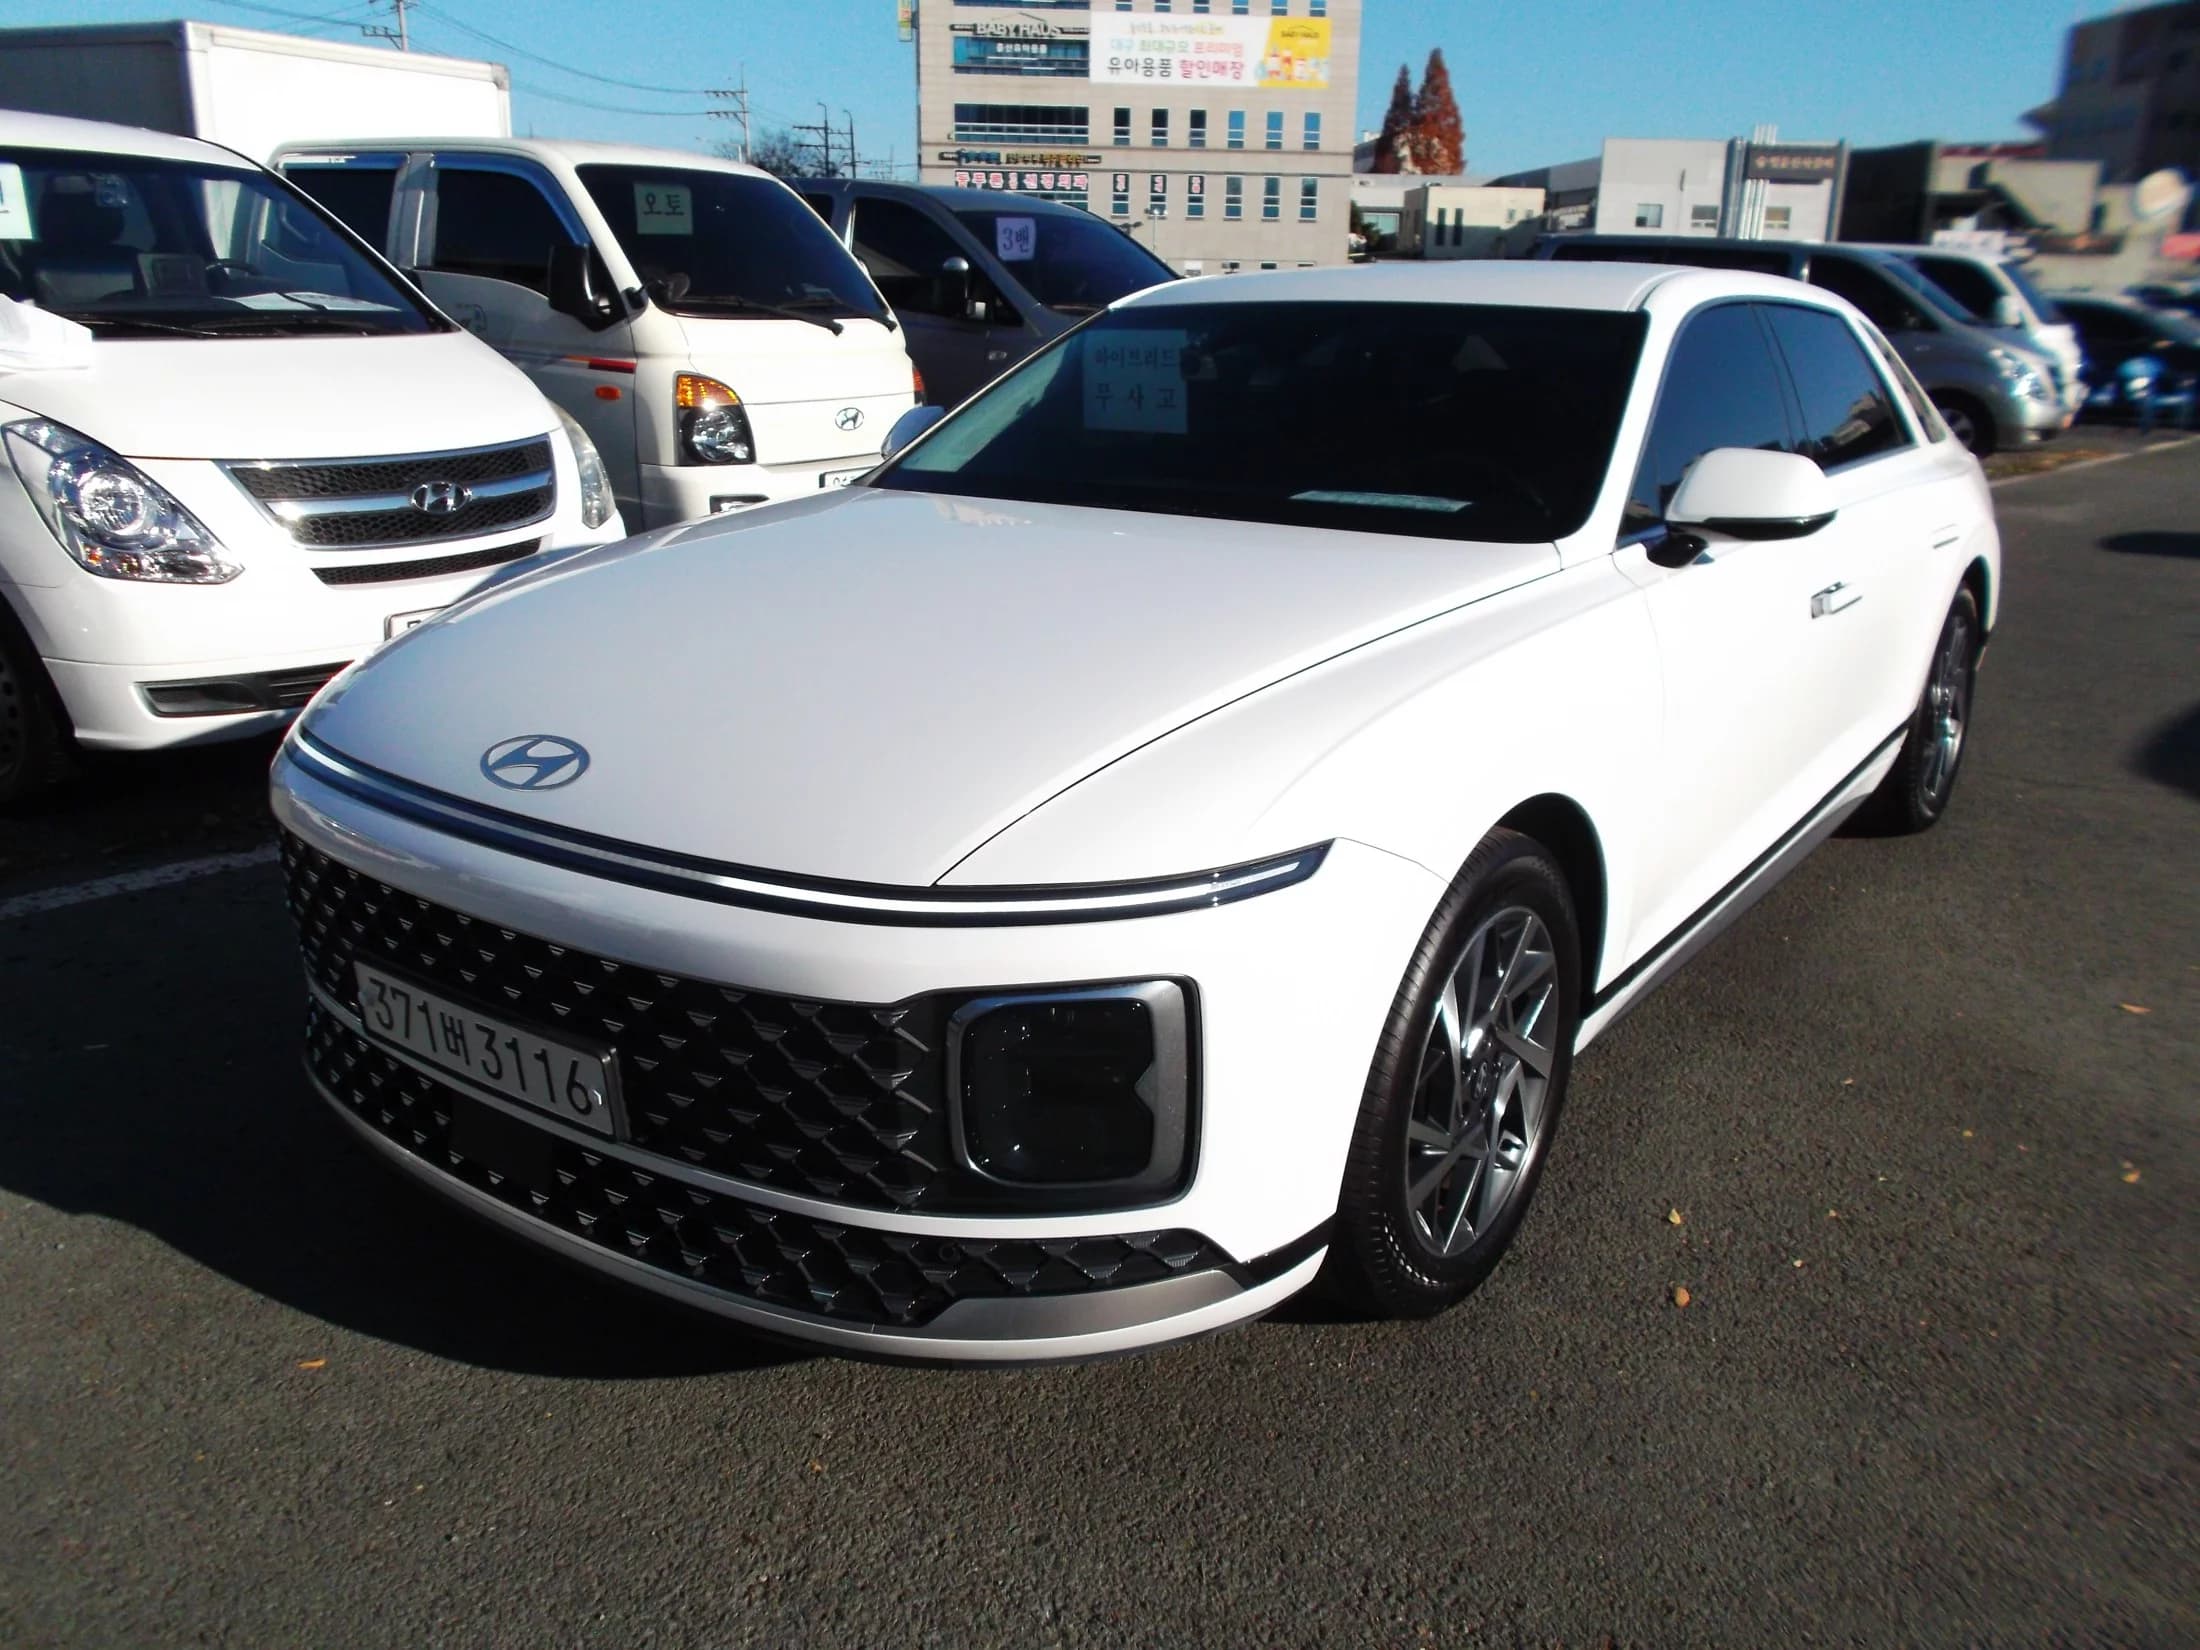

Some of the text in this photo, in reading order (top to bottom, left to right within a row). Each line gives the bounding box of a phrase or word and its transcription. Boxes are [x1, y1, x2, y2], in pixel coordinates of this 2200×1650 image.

[977, 23, 1015, 36] BABY
[1019, 24, 1062, 37] HAUS
[1139, 40, 1190, 53] 최대규모
[1108, 56, 1245, 80] 유아용품 할인매장
[642, 192, 685, 216] 오토
[369, 977, 593, 1116] 371버3116
